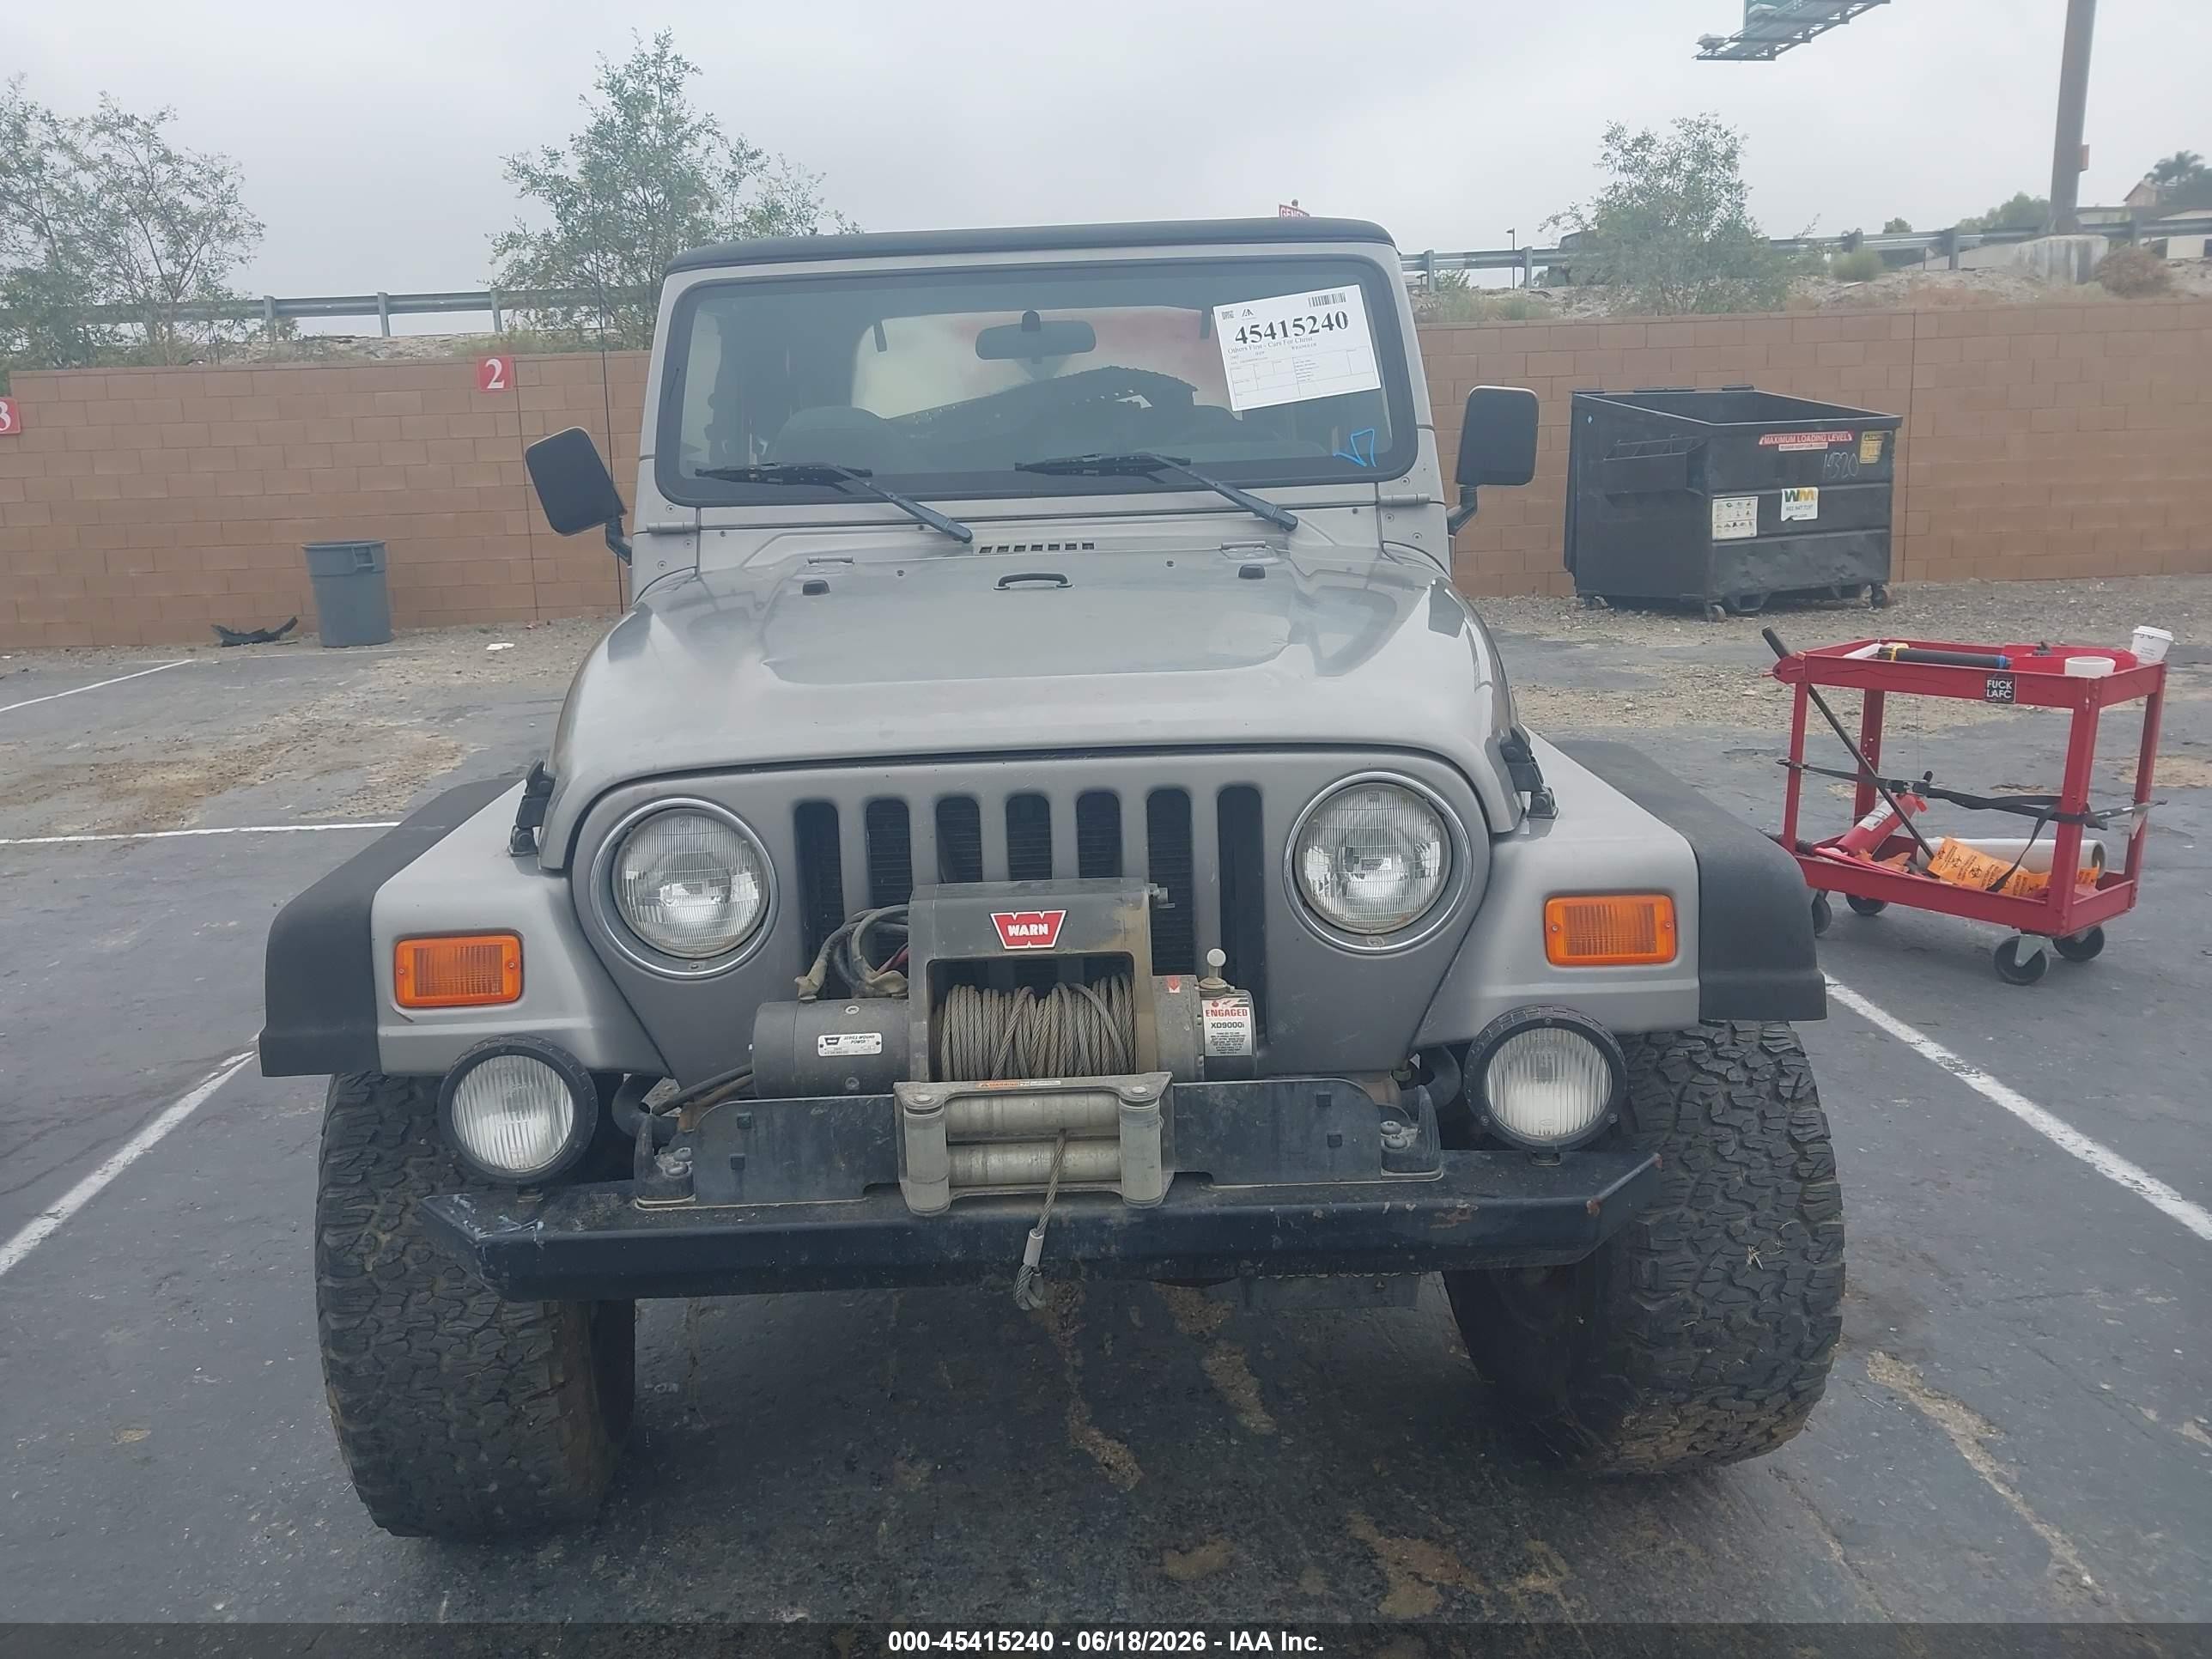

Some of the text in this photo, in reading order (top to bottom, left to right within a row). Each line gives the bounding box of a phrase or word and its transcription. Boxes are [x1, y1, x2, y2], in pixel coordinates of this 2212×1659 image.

[1235, 310, 1349, 345] 45415240
[485, 358, 505, 389] 2
[1764, 432, 1849, 444] MAXIMUM LOADING LEVEL
[1784, 489, 1814, 502] WM
[1986, 679, 2013, 690] FUCK
[1986, 689, 2012, 699] LAFC
[1007, 923, 1048, 937] WARN
[1205, 1008, 1248, 1018] ENGAGED
